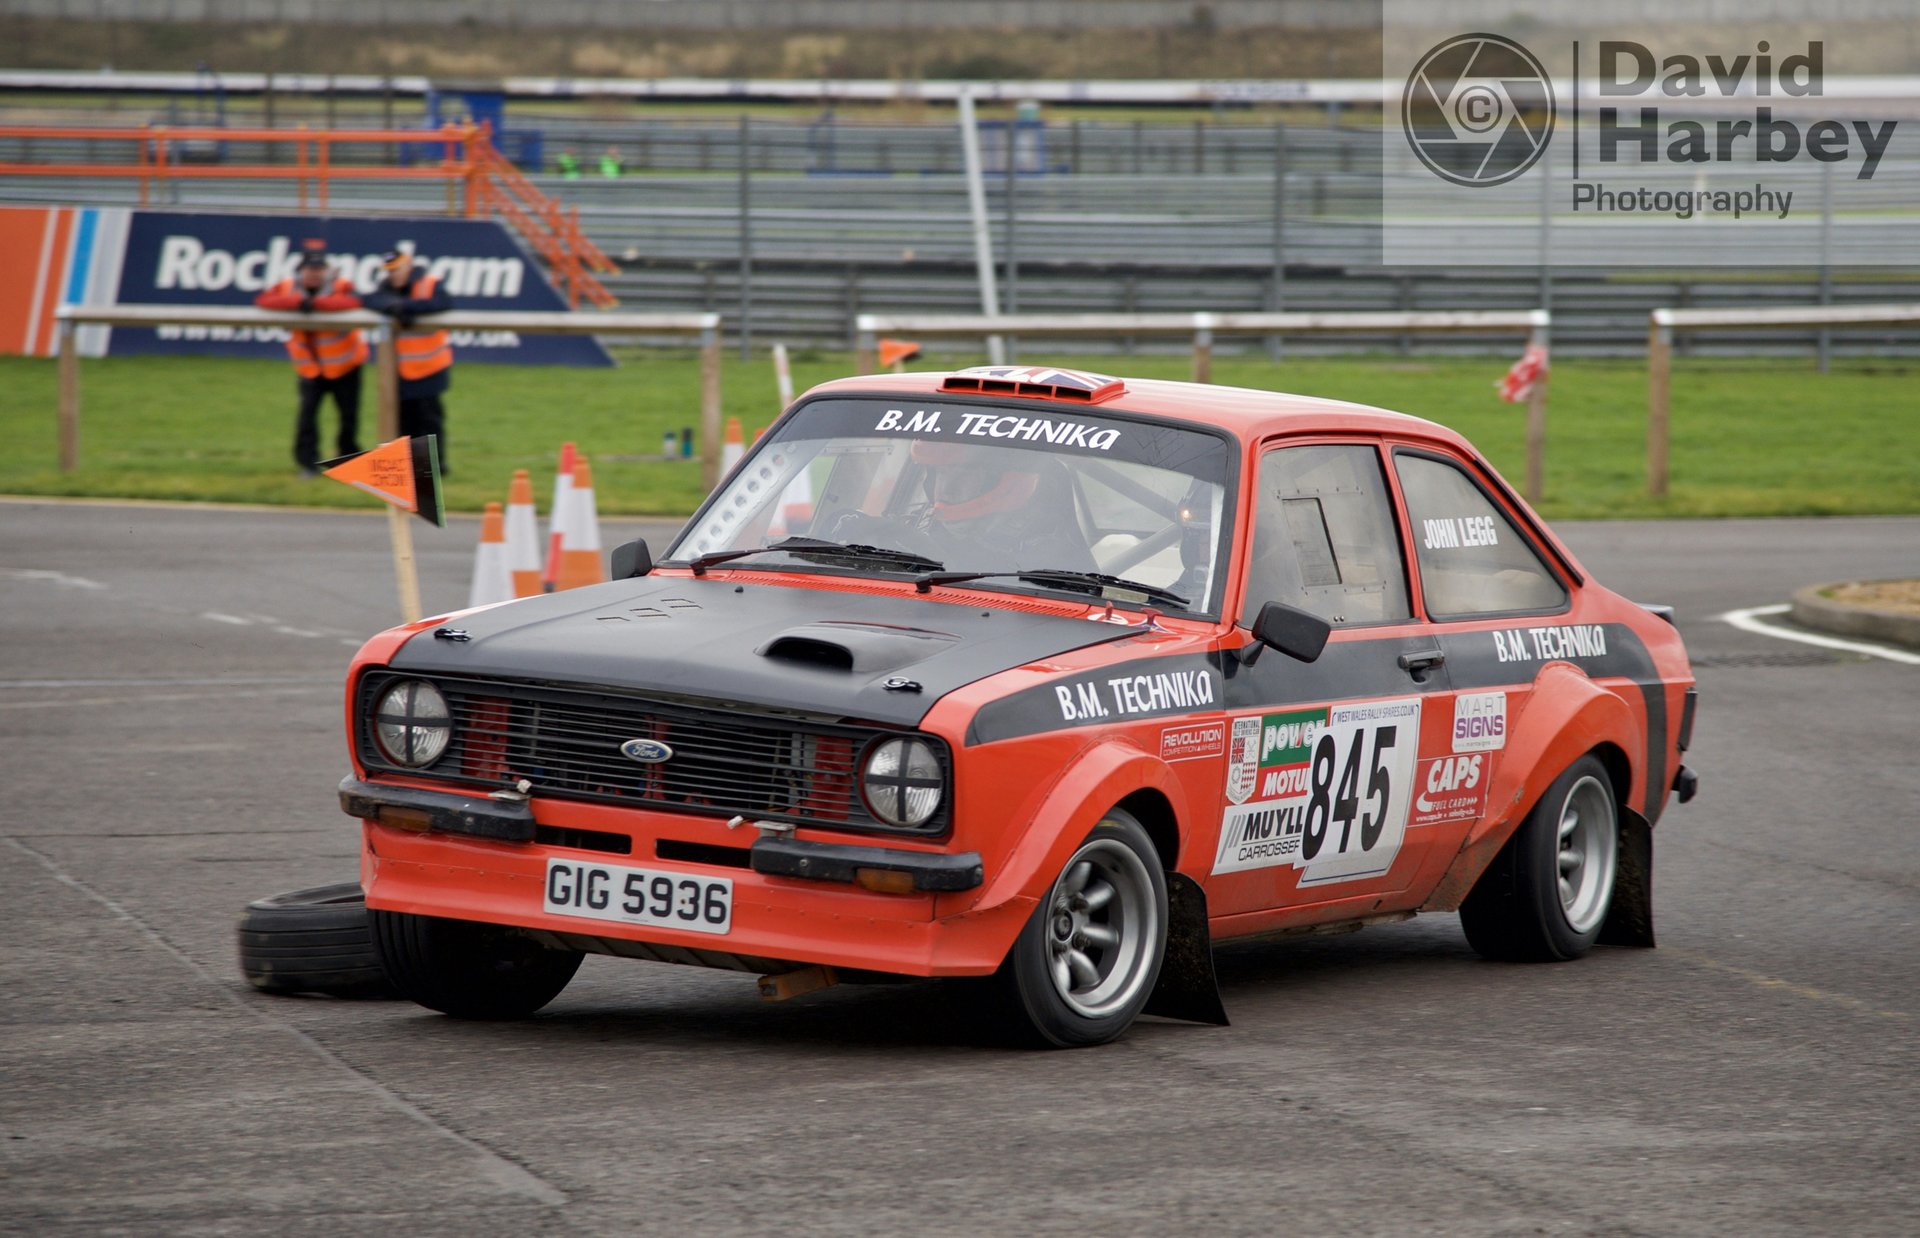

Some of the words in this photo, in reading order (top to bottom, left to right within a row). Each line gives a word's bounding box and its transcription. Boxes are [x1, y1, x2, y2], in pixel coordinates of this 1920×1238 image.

[875, 409, 942, 433] B.M.
[1423, 518, 1459, 549] JOHN
[1457, 516, 1498, 547] LEGG
[1493, 629, 1531, 662] B.M.
[1055, 682, 1109, 721] B.M.
[1456, 696, 1505, 717] MART
[1164, 729, 1222, 748] REVOLUTION
[1455, 714, 1504, 739] SIGNS
[632, 743, 660, 758] Ford
[1427, 754, 1483, 794] CAPS
[1302, 726, 1397, 860] 845
[548, 864, 610, 910] GIG
[622, 873, 728, 924] 5936
